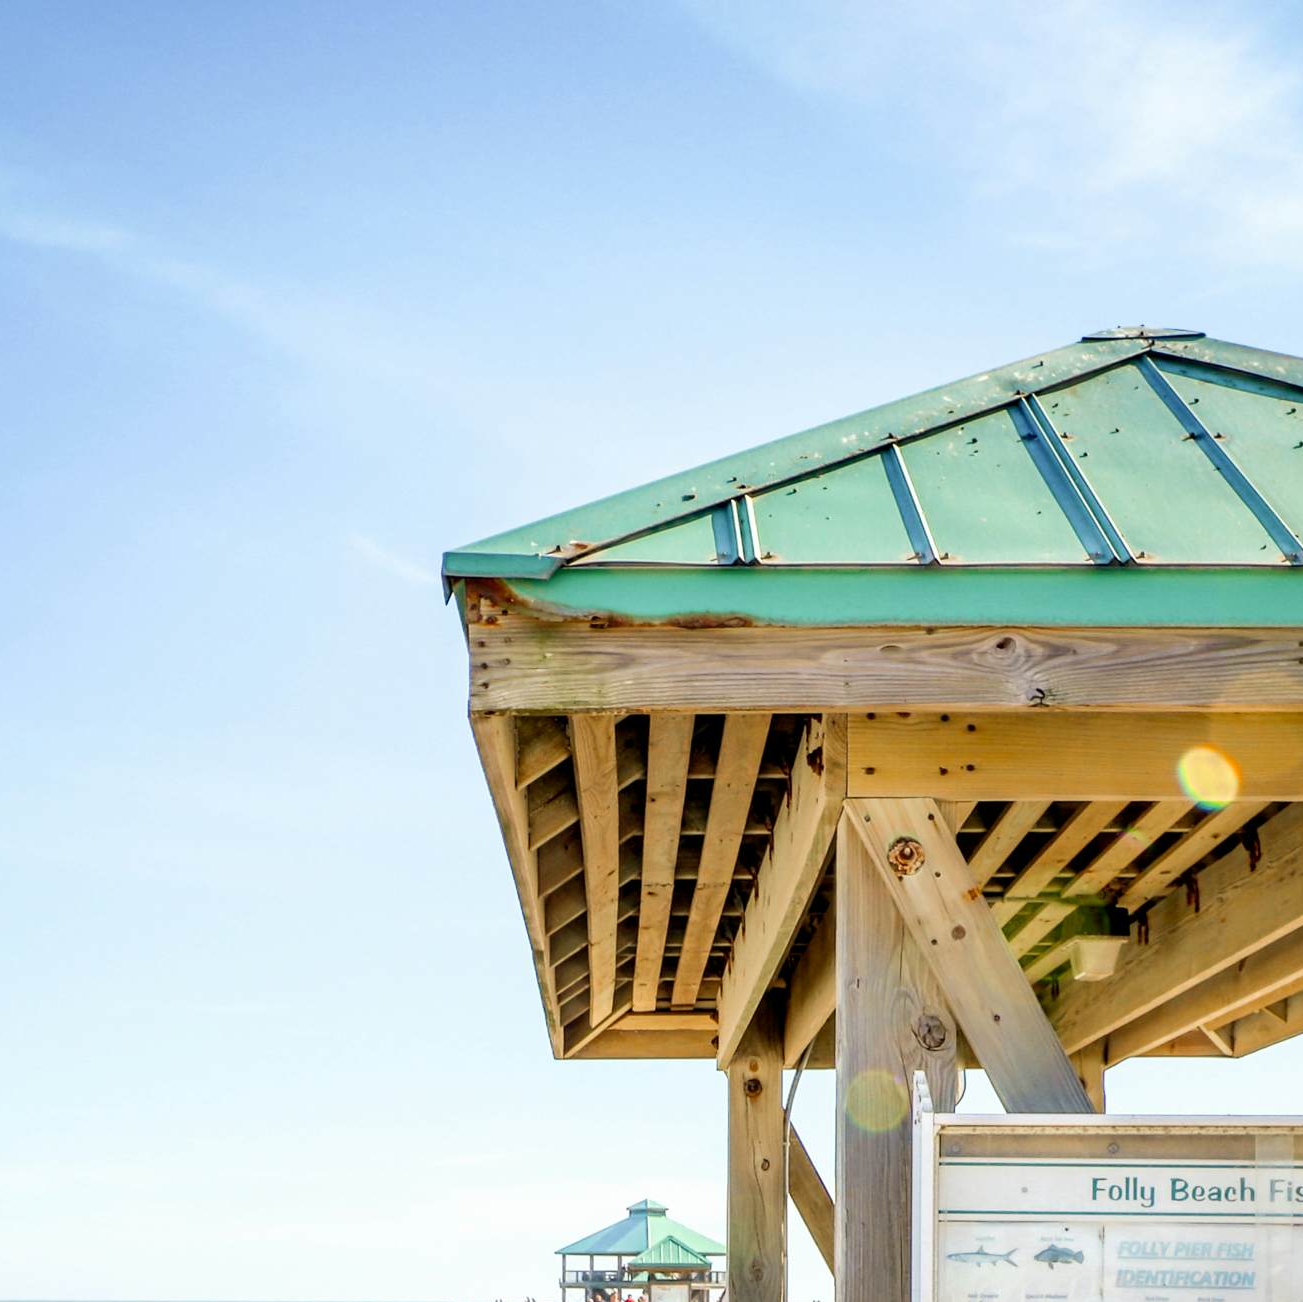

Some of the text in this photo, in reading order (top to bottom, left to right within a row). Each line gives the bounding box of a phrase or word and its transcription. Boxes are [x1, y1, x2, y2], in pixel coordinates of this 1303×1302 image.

[1092, 1176, 1155, 1208] Folly
[1170, 1177, 1256, 1202] Beach
[1118, 1241, 1255, 1258] FOLLY PIER FISH
[1115, 1270, 1256, 1287] IDENTIFICATION
